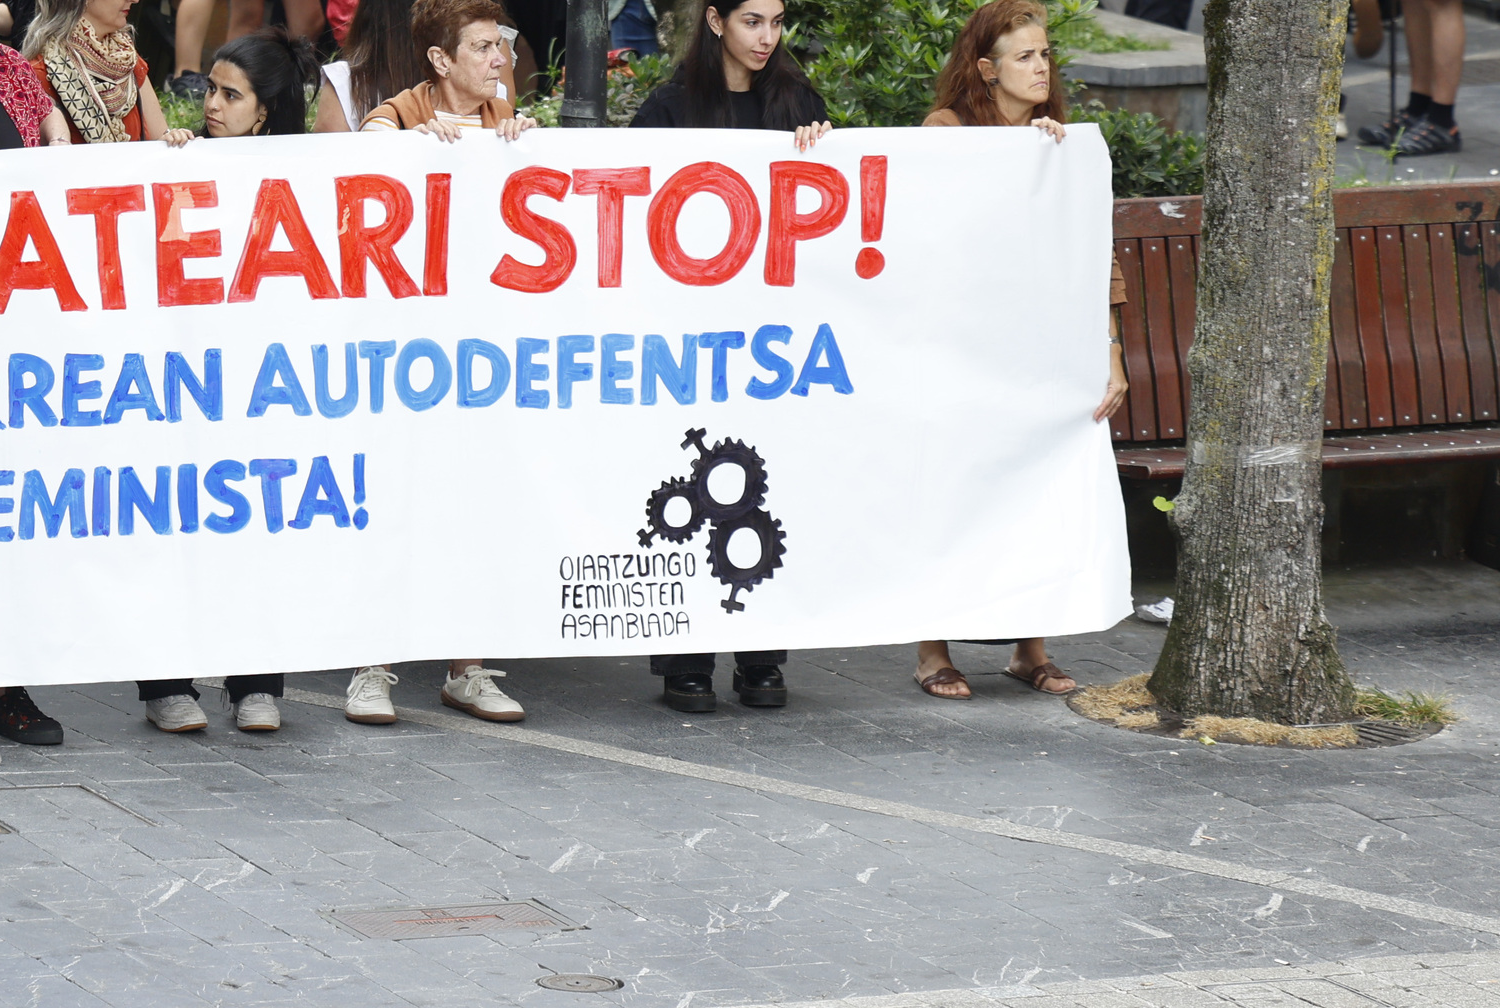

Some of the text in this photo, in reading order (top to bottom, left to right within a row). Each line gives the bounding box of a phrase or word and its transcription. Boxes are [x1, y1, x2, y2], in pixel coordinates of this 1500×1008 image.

[490, 155, 888, 293] STOP!
[246, 323, 854, 419] AUTODEFENTSA
[559, 552, 696, 581] OIARTZUNGO
[561, 581, 684, 609] FEMINISTEN
[561, 611, 690, 640] ASANBLADA
